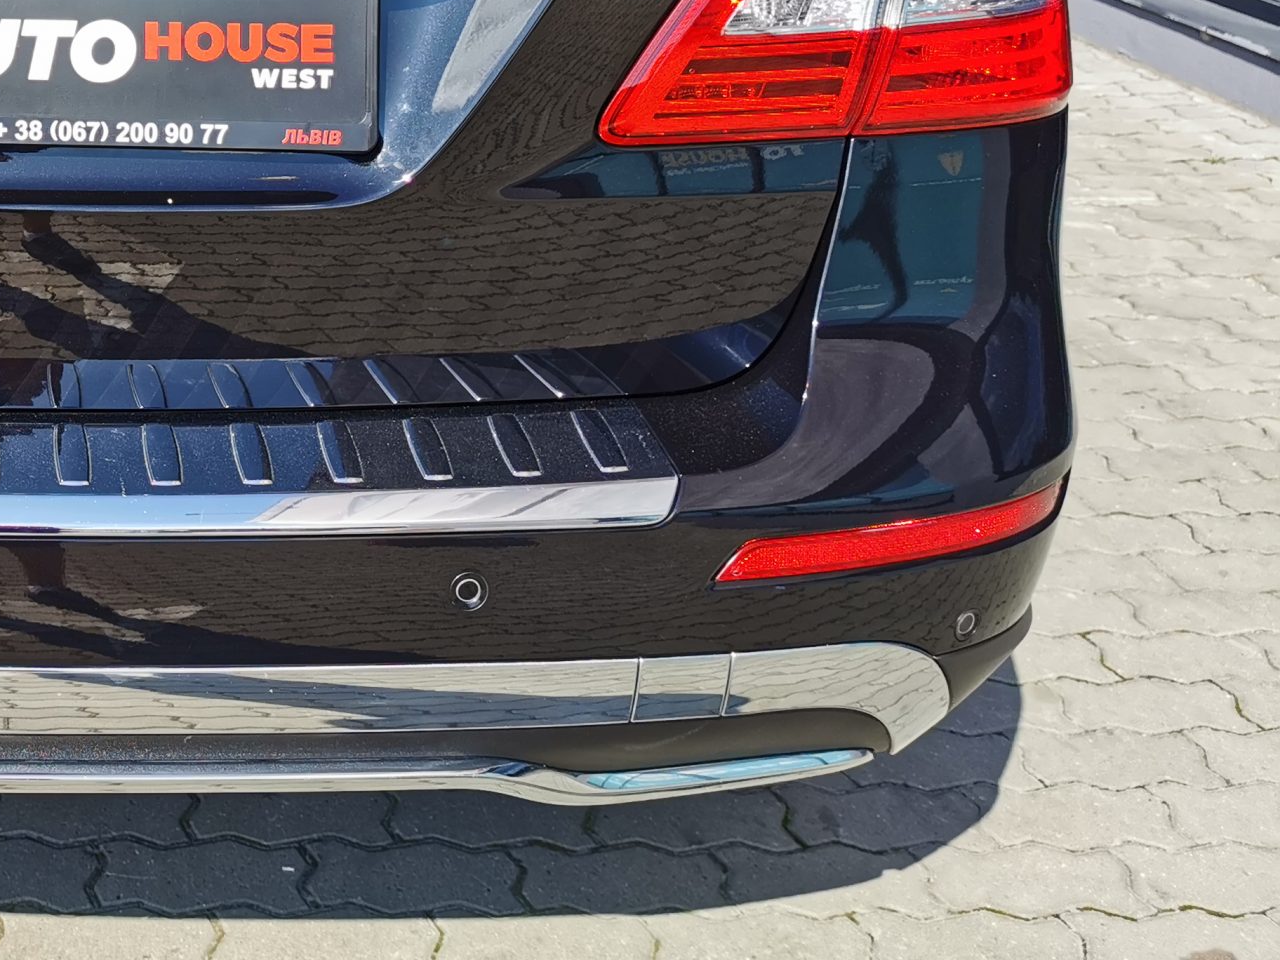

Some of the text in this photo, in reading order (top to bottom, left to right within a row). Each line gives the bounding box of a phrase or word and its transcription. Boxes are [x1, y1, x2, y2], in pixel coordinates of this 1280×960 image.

[144, 20, 335, 63] HOUSE
[251, 67, 334, 90] WEST
[14, 120, 43, 141] 38
[49, 120, 109, 143] (067)
[115, 122, 158, 143] 200
[164, 122, 193, 144] 90
[200, 123, 229, 144] 77
